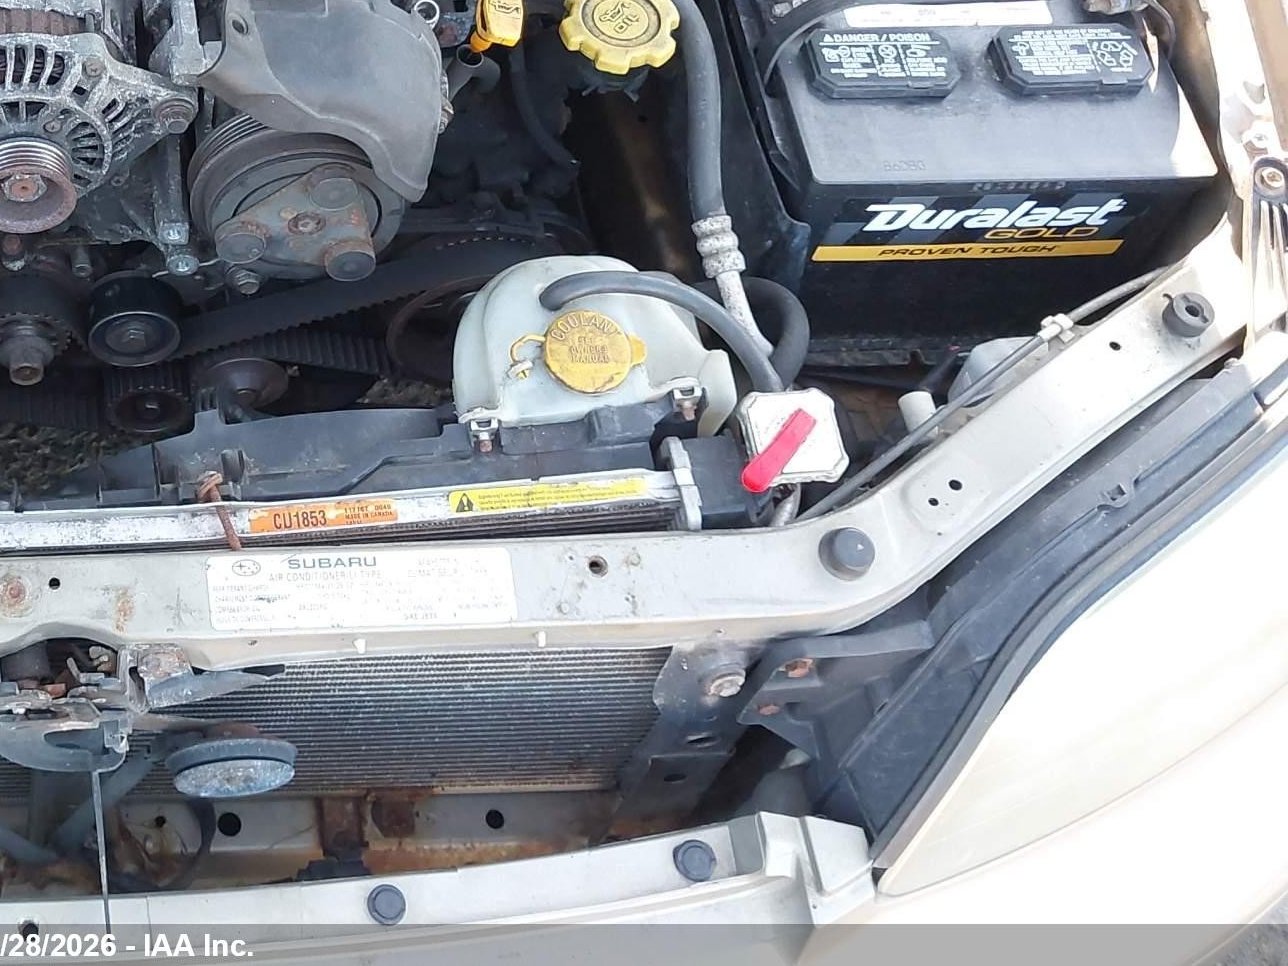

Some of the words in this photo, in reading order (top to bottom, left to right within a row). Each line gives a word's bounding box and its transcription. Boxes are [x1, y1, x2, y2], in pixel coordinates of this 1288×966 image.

[614, 13, 640, 34] OIL
[834, 33, 879, 43] DANGER
[889, 33, 931, 42] POISON
[862, 198, 1127, 232] Duralast
[984, 227, 1100, 240] GOLD
[878, 246, 973, 257] PROVEN
[980, 244, 1057, 255] TOUGH
[272, 509, 327, 530] CU1853
[287, 555, 377, 570] SUBARU
